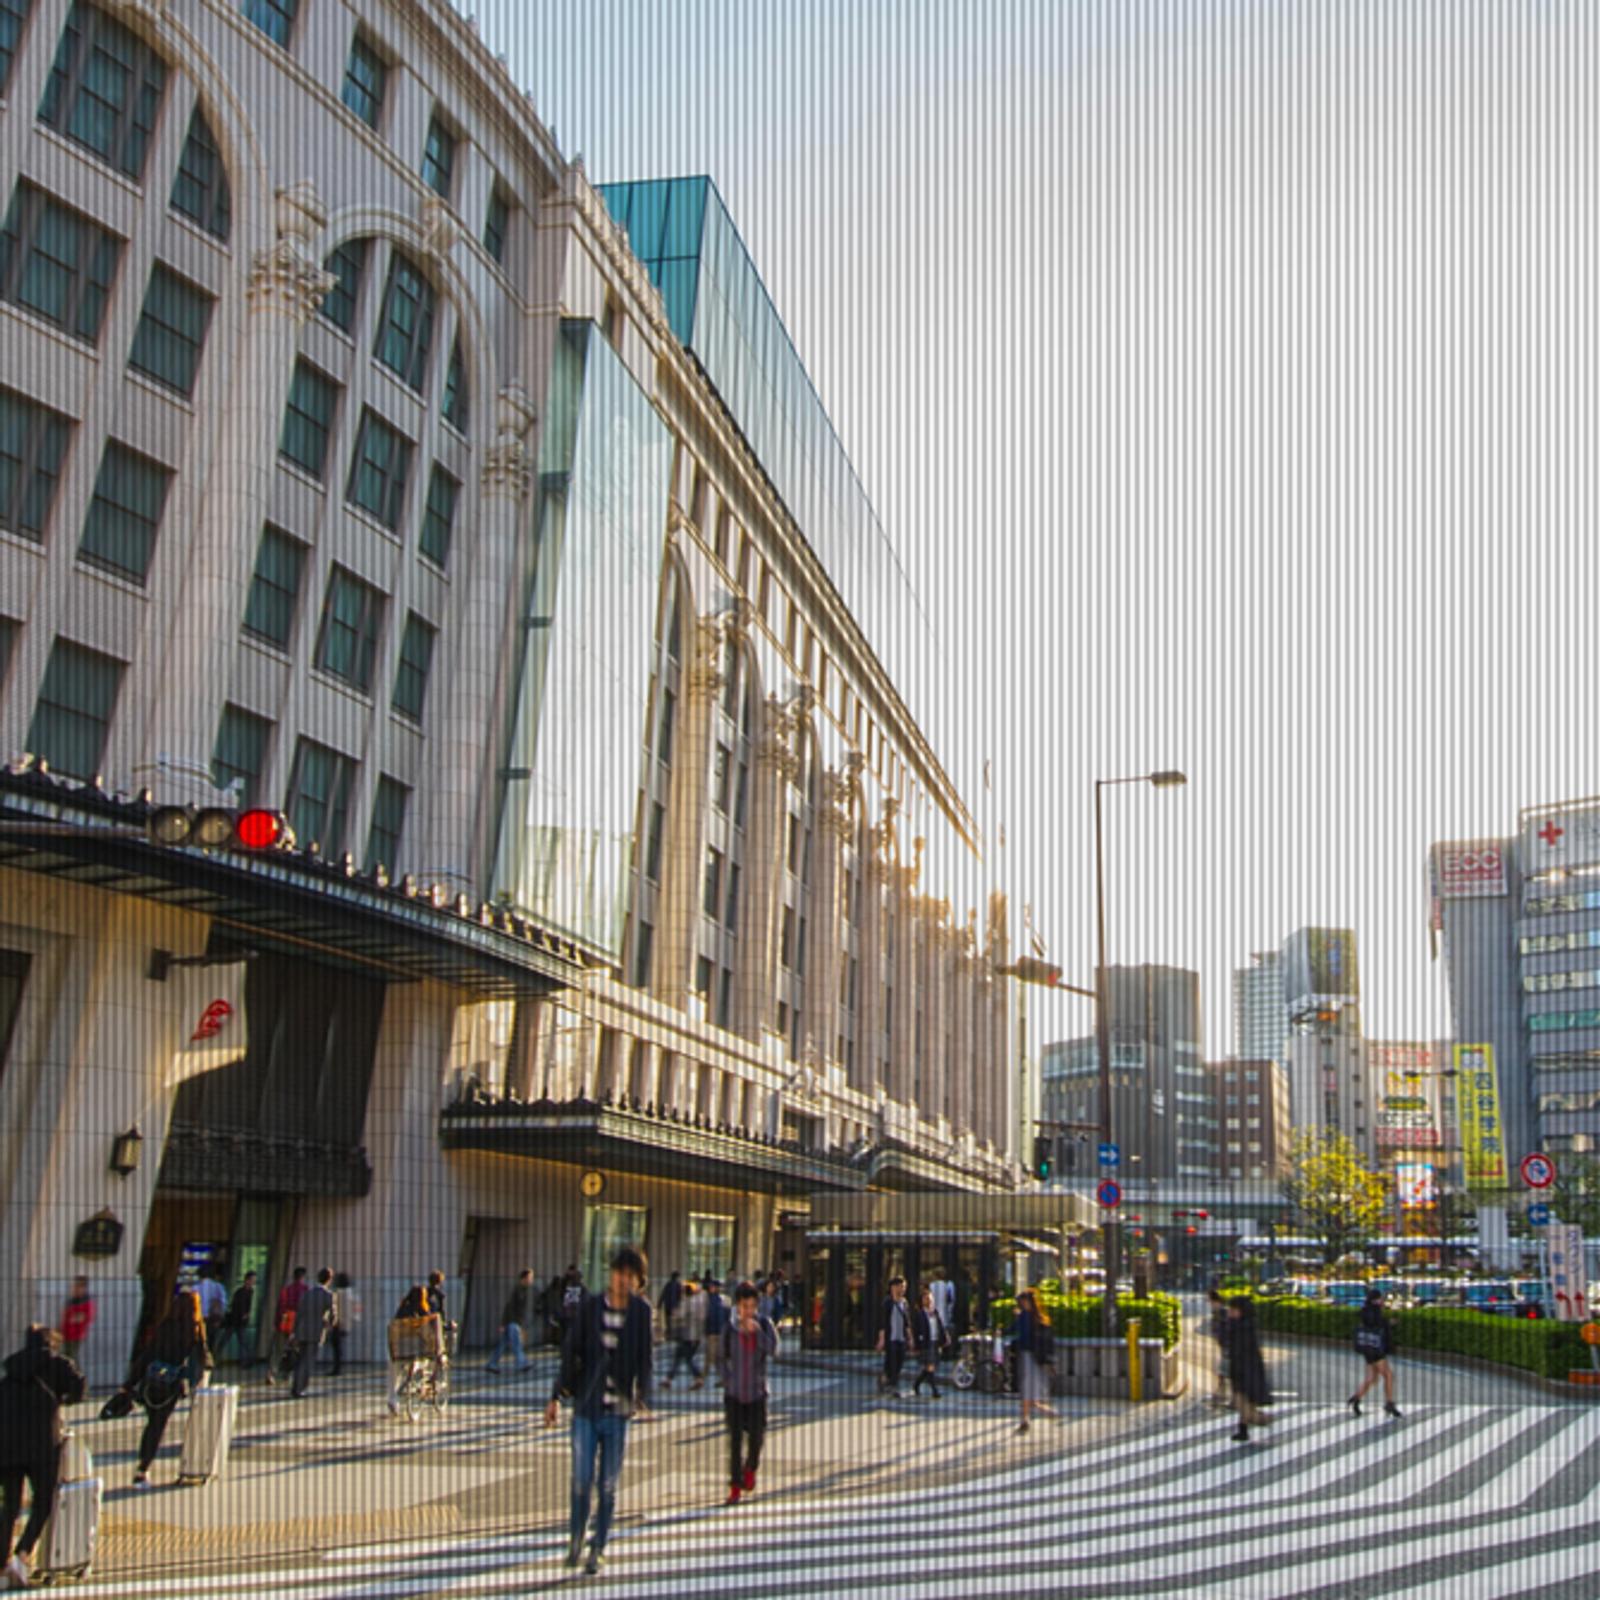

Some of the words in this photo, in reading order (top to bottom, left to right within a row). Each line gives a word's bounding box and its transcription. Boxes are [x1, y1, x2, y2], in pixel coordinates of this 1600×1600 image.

[1443, 850, 1499, 872] ECC
[1474, 1071, 1501, 1154] 四谷学院
[1566, 1229, 1582, 1287] タクシー
